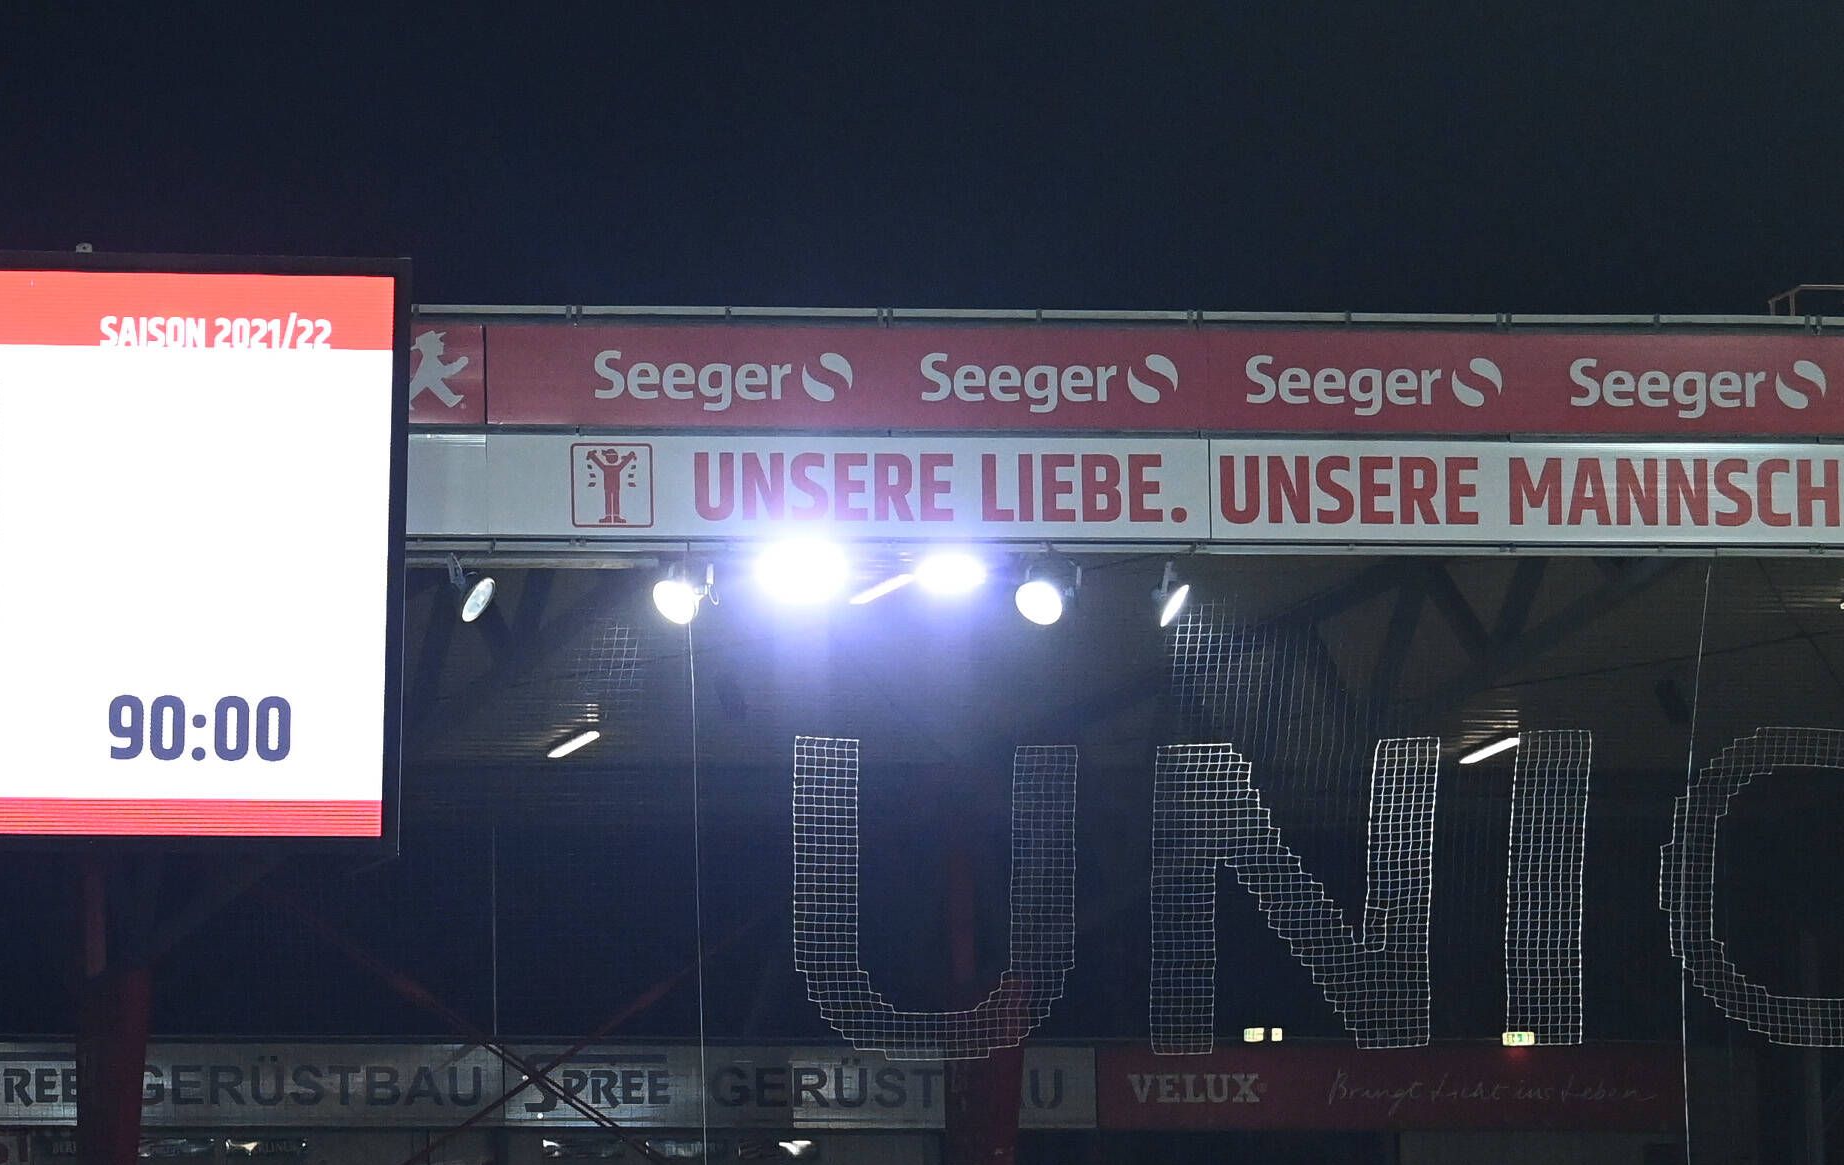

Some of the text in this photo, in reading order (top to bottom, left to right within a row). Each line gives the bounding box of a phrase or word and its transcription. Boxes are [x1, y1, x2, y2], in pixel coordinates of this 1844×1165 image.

[100, 311, 332, 349] SAISON 2021/22
[594, 350, 791, 412] Seeger
[920, 353, 1116, 414] Seeger
[1245, 355, 1441, 416] Seeger
[1570, 358, 1765, 418] Seeger
[693, 451, 1840, 528] UNSERE LIEBE. UNSERE MANNSCH
[109, 695, 291, 762] 90:00
[142, 1056, 482, 1107] GERÜSTBAU
[524, 1053, 1064, 1113] SPREE GERÜSTU
[1128, 1073, 1262, 1104] VELUX
